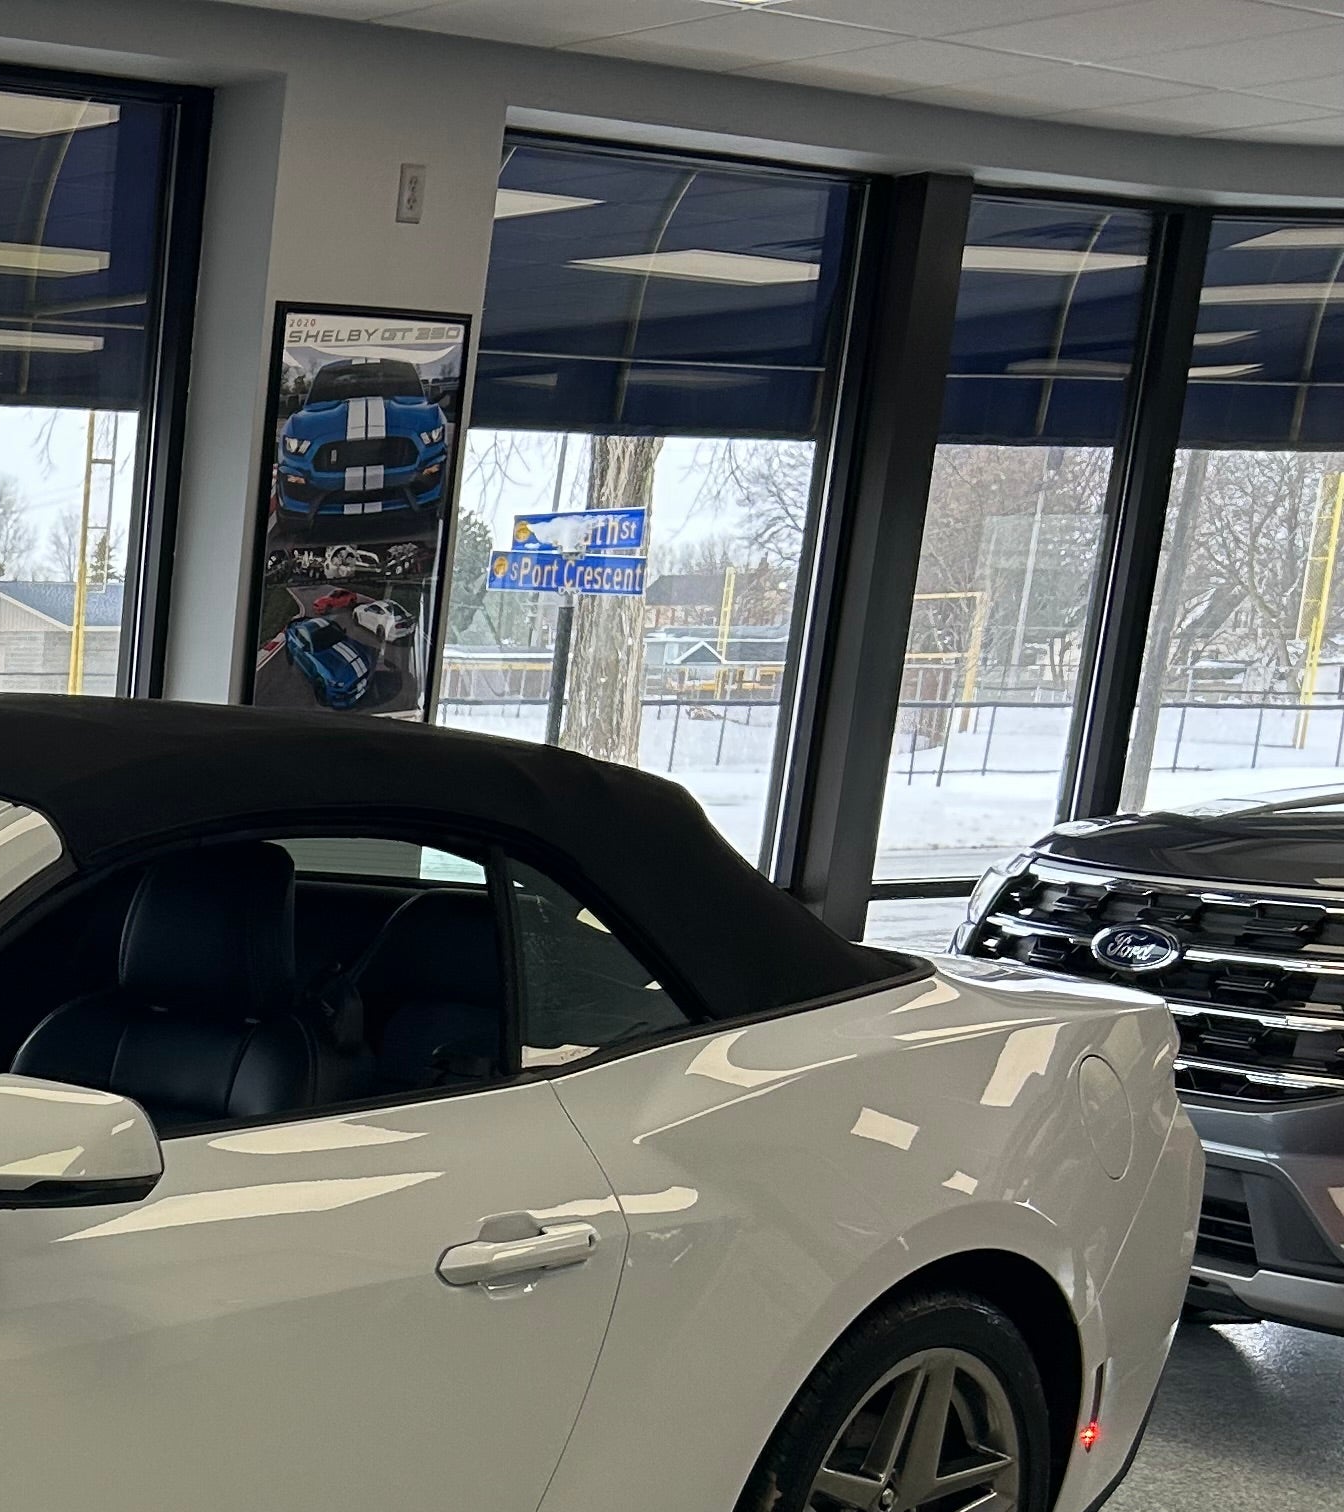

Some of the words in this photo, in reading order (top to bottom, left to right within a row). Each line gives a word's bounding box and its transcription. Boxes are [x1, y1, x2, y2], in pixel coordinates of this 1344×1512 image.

[288, 318, 316, 328] 2020
[287, 328, 379, 343] SHELBY
[518, 556, 559, 588] Port
[563, 559, 642, 591] Crescent
[1106, 931, 1156, 961] Ford
